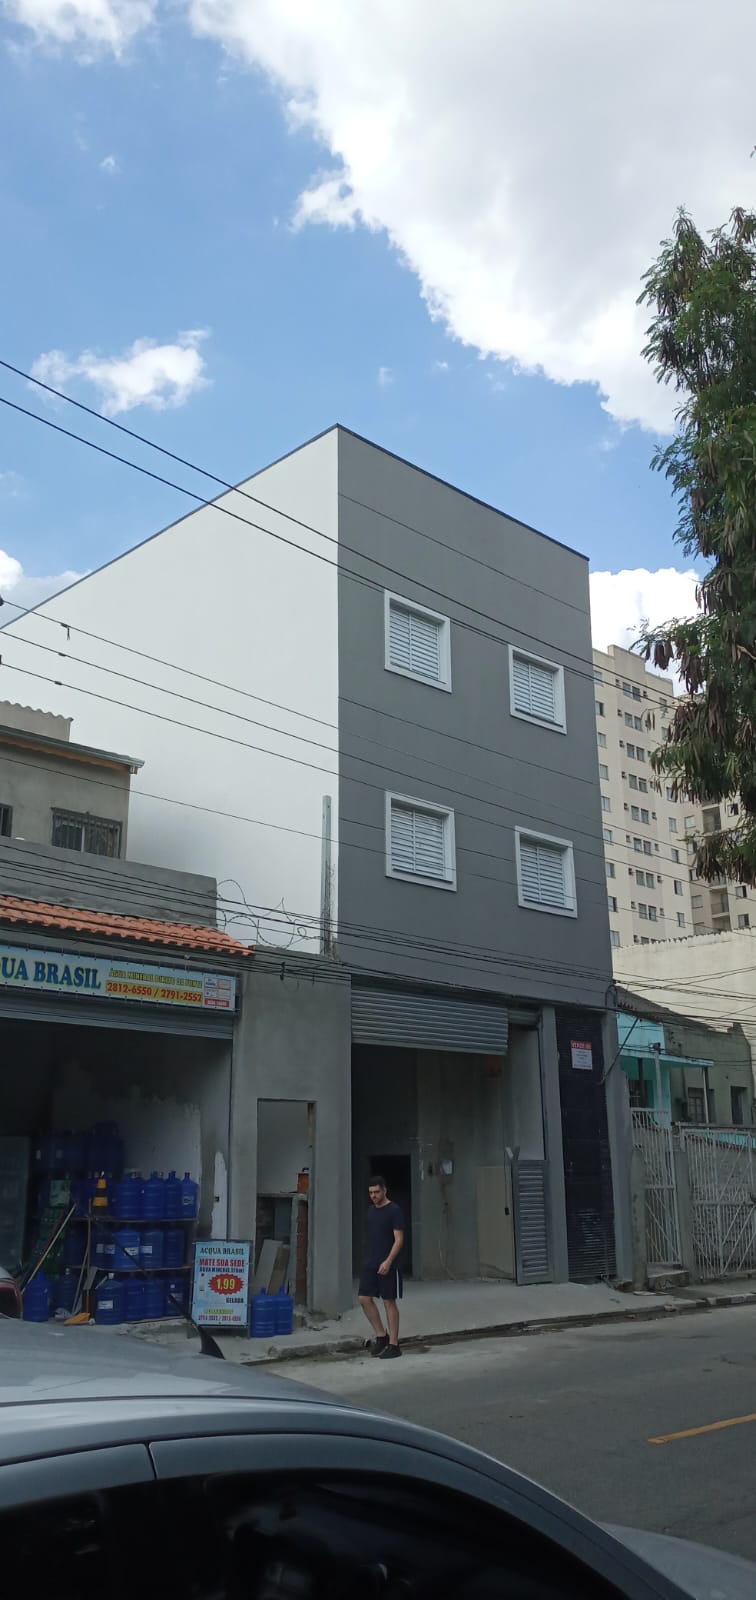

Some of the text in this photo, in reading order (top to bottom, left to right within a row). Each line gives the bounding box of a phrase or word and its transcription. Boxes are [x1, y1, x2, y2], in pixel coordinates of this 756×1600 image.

[0, 957, 101, 989] UA BRASIL
[107, 982, 152, 995] 2812-6550
[161, 988, 202, 1002] 2791-2552
[200, 1247, 244, 1255] ACQUA BRASIL
[199, 1258, 245, 1267] MATE SUA SEDE
[216, 1278, 236, 1290] 1,99
